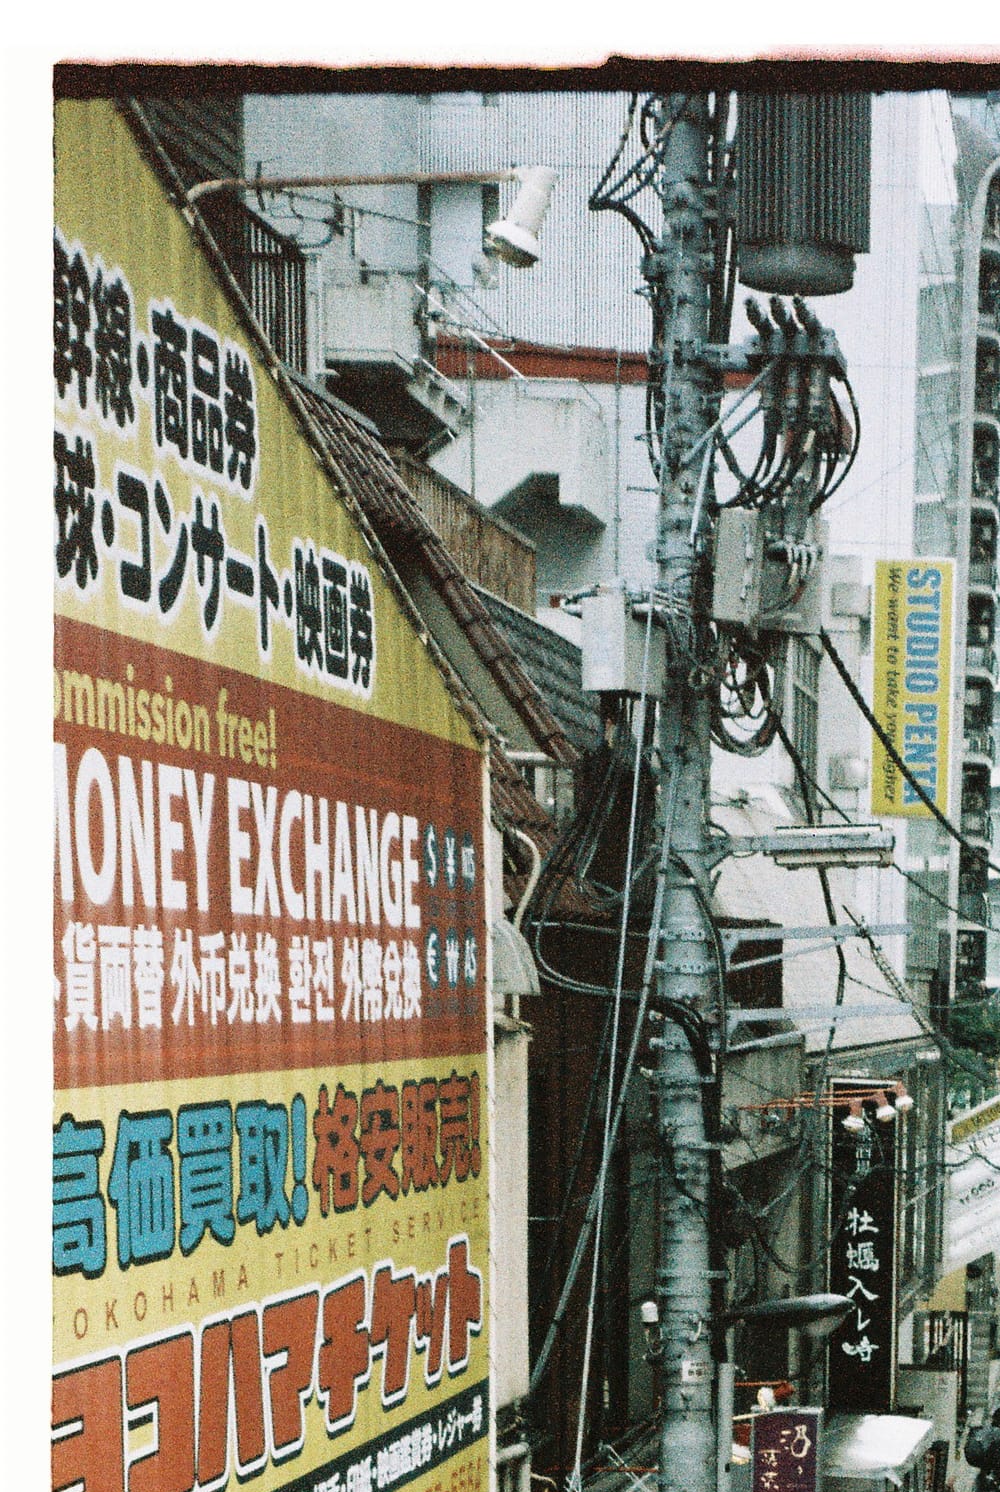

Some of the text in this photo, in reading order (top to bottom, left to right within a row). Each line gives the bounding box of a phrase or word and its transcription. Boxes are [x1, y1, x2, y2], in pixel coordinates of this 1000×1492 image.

[886, 591, 900, 641] want
[886, 648, 898, 666] to
[884, 671, 900, 710] take
[902, 567, 943, 805] STUDIO PENTA
[215, 688, 278, 770] free!
[883, 747, 897, 804] igher
[226, 776, 422, 929] EXCHANGE
[53, 921, 165, 1033] 貨両替
[288, 936, 335, 1024] 환전
[53, 1202, 482, 1341] OKOHAMA TICKET SERVICE
